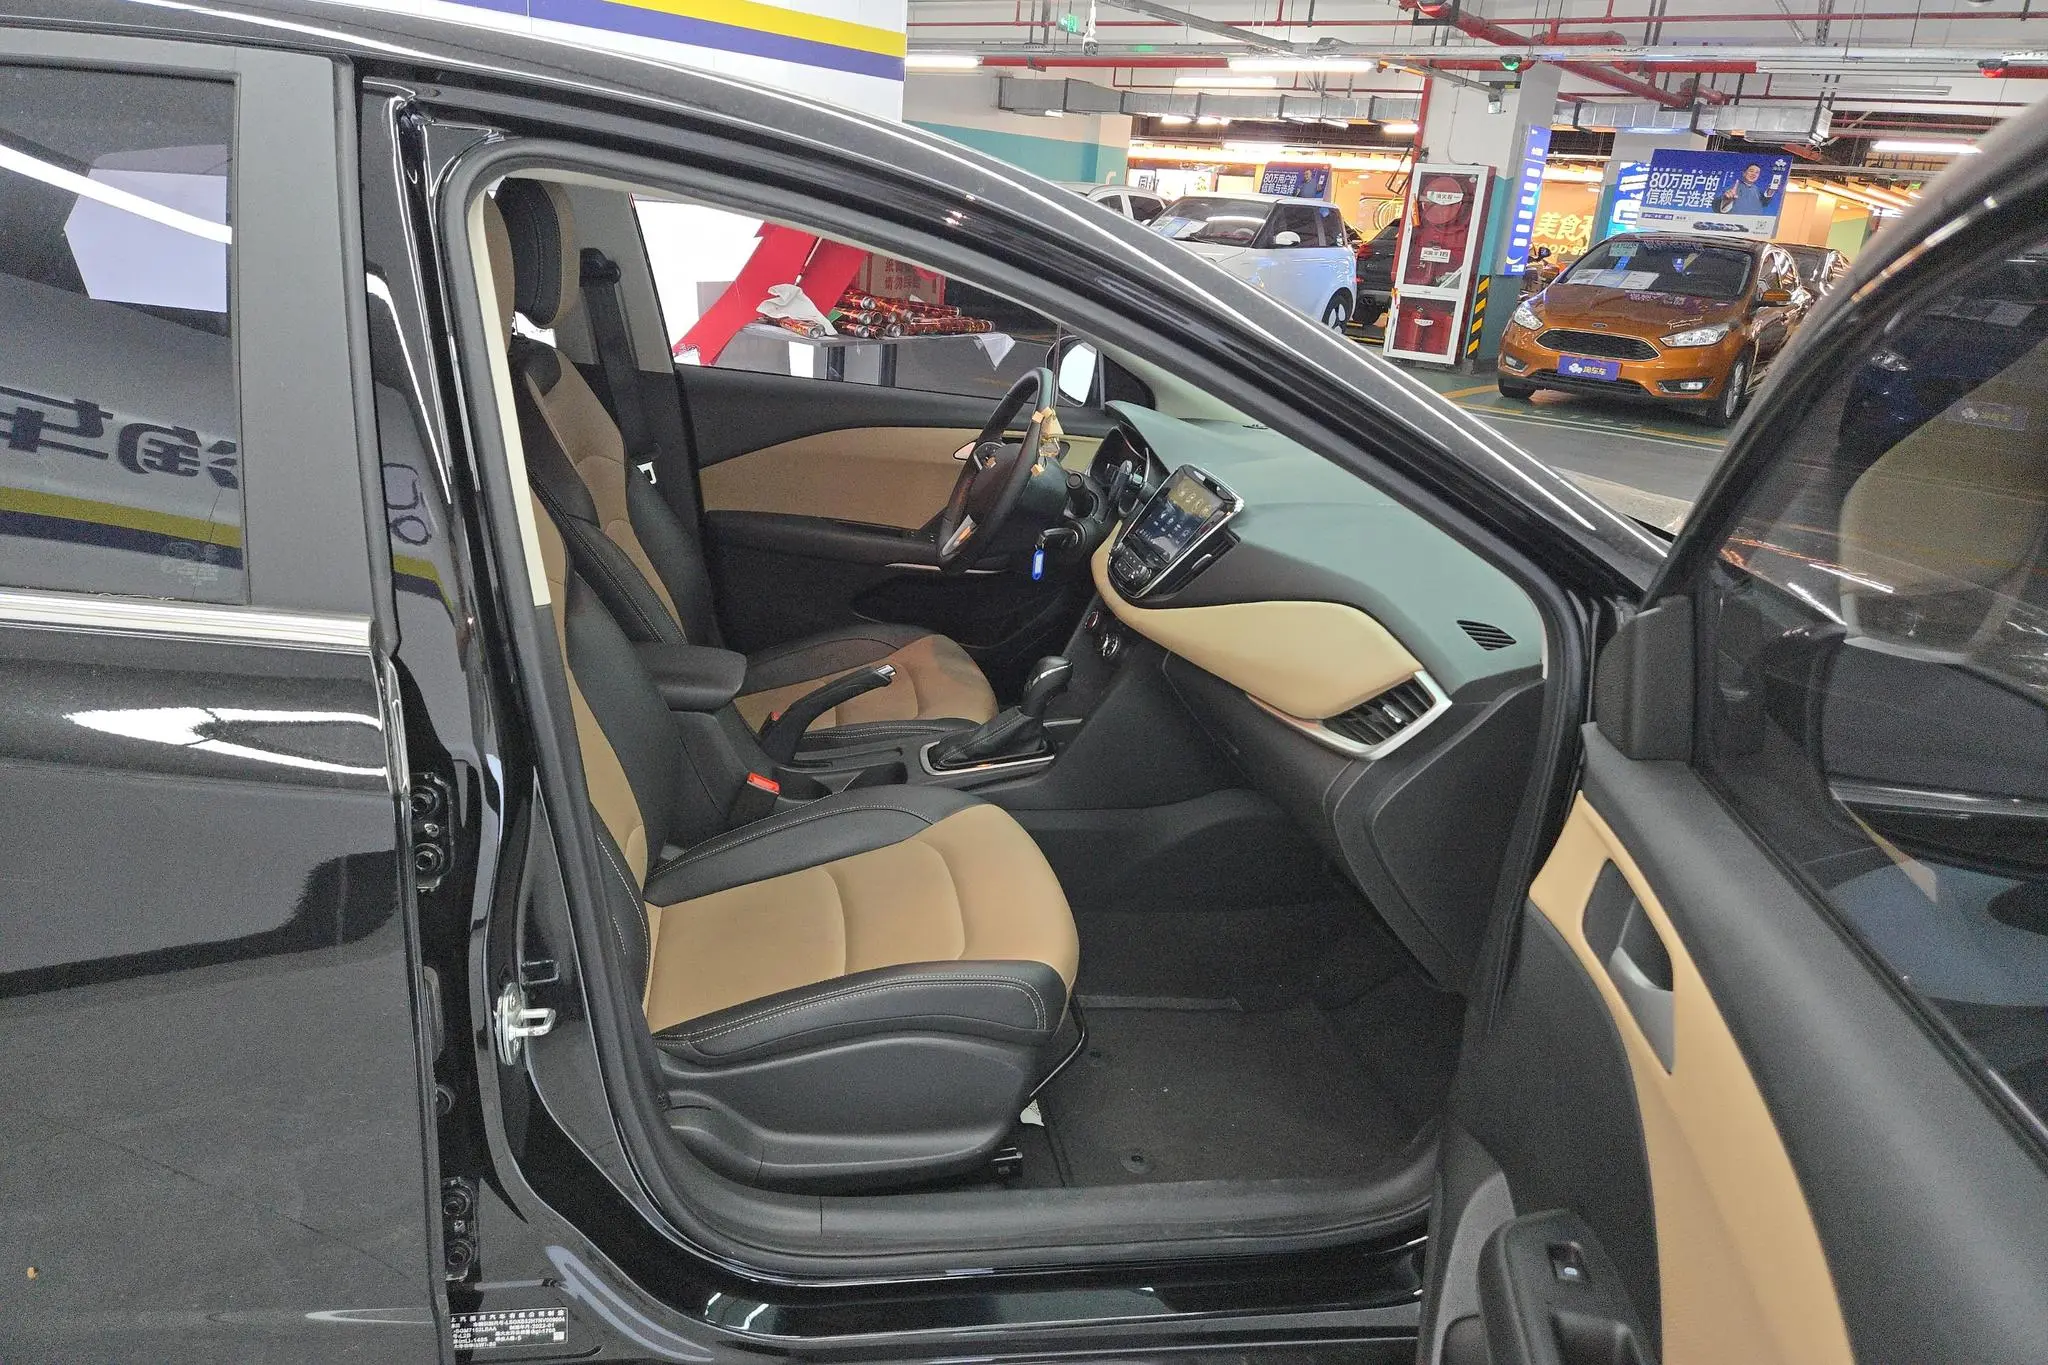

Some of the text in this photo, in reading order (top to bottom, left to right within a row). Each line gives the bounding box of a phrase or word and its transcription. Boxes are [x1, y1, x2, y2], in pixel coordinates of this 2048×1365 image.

[1649, 172, 1720, 192] 80万用户的
[1645, 188, 1716, 208] 信赖与选择
